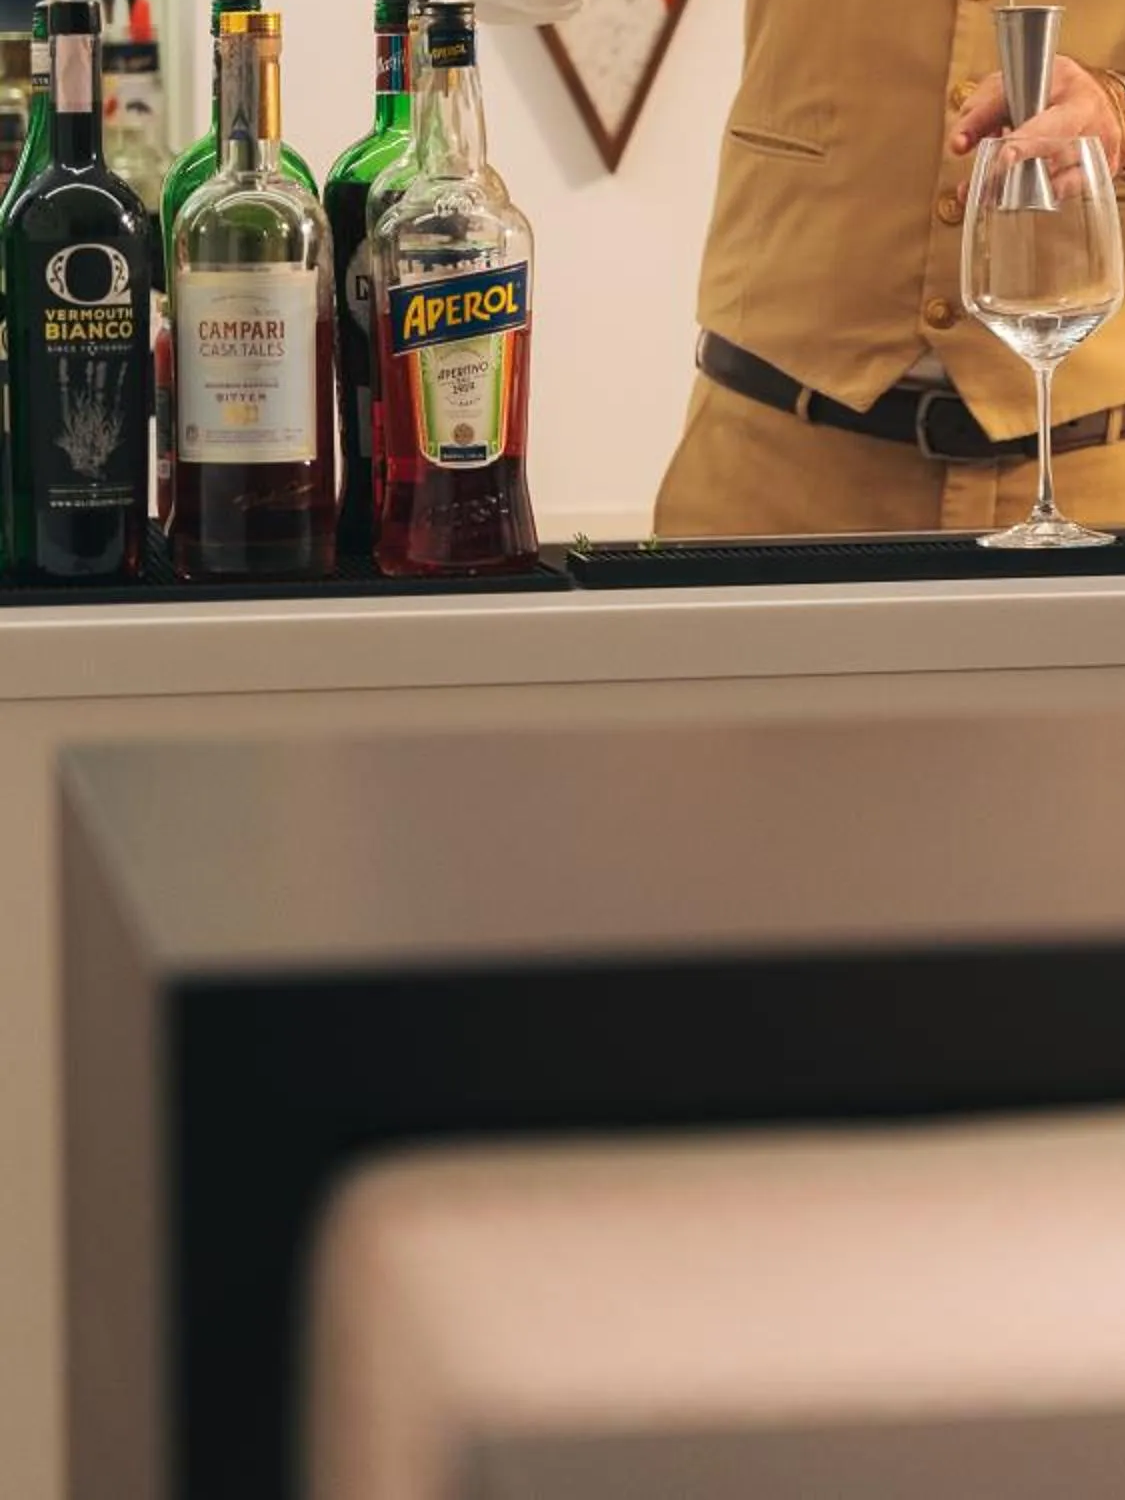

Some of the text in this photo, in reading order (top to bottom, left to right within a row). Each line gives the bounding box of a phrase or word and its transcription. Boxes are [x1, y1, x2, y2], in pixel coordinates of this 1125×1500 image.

[45, 243, 131, 305] Q
[45, 308, 133, 320] VERMOUTH
[403, 281, 519, 340] APEROL
[45, 321, 133, 340] BIANCO
[199, 320, 285, 341] CAMPARI
[437, 361, 489, 380] APERITIVO
